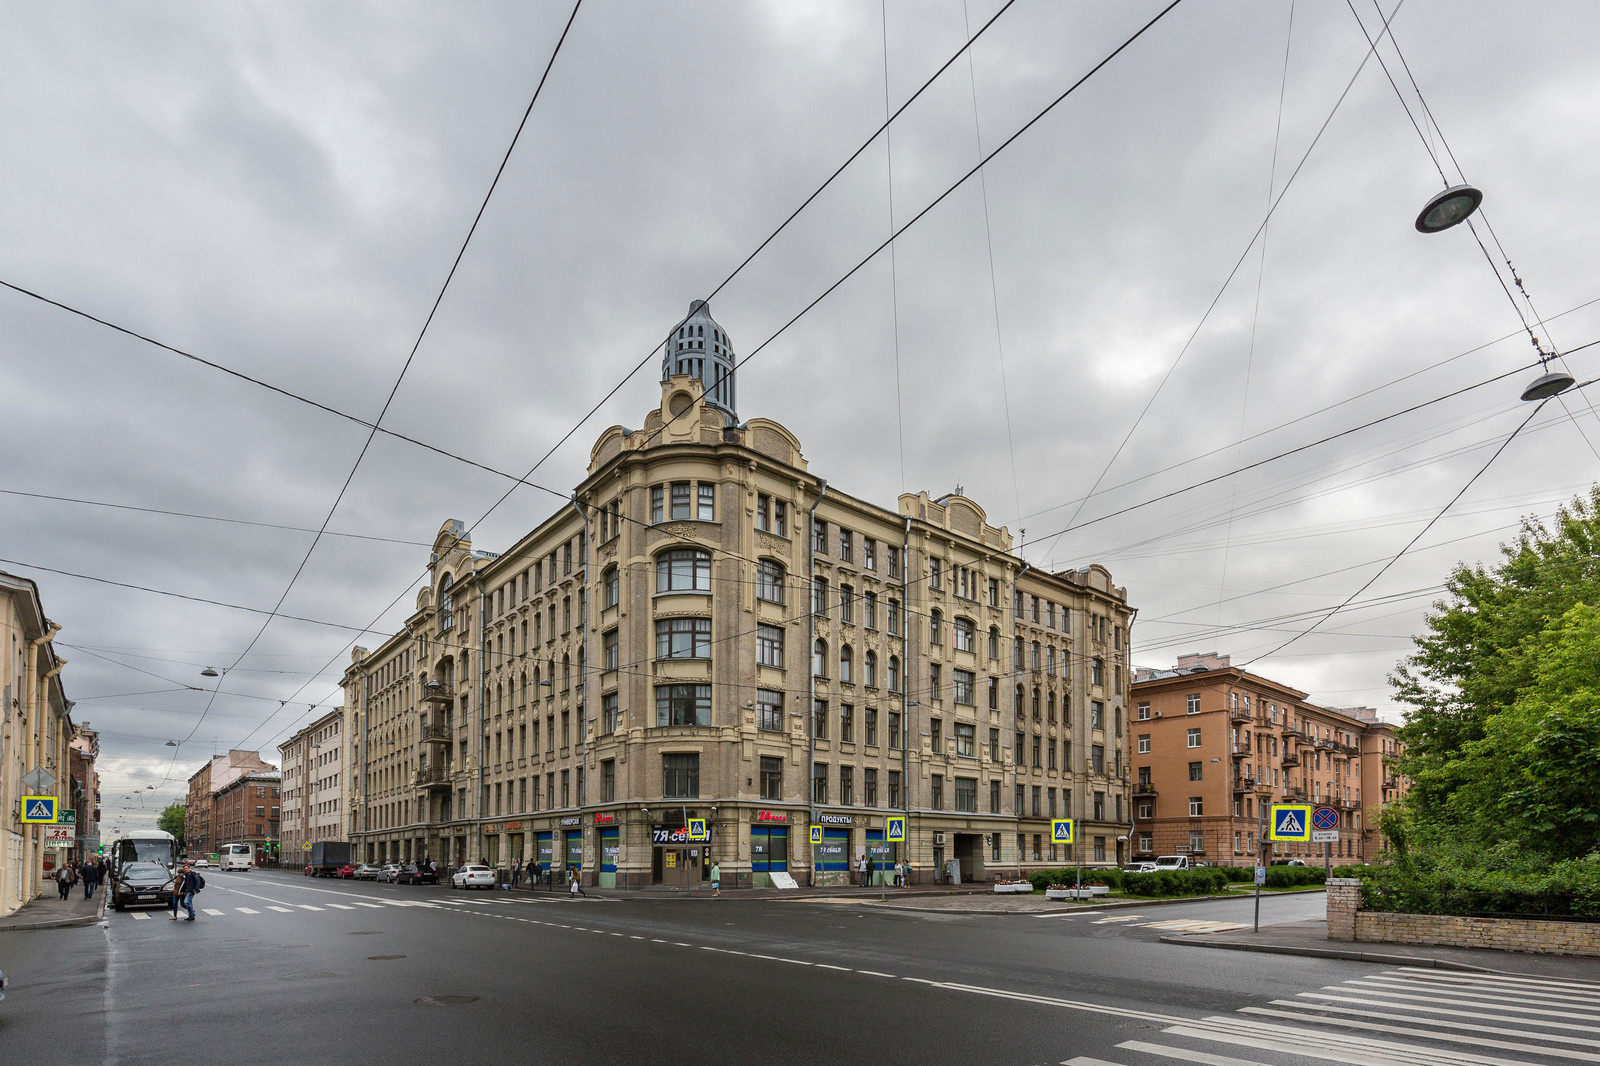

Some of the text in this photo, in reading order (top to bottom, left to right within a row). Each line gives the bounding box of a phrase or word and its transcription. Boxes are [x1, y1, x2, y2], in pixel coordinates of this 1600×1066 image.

[595, 812, 602, 822] 24
[760, 810, 771, 820] 24
[821, 815, 852, 823] ПРОДУКТЫ
